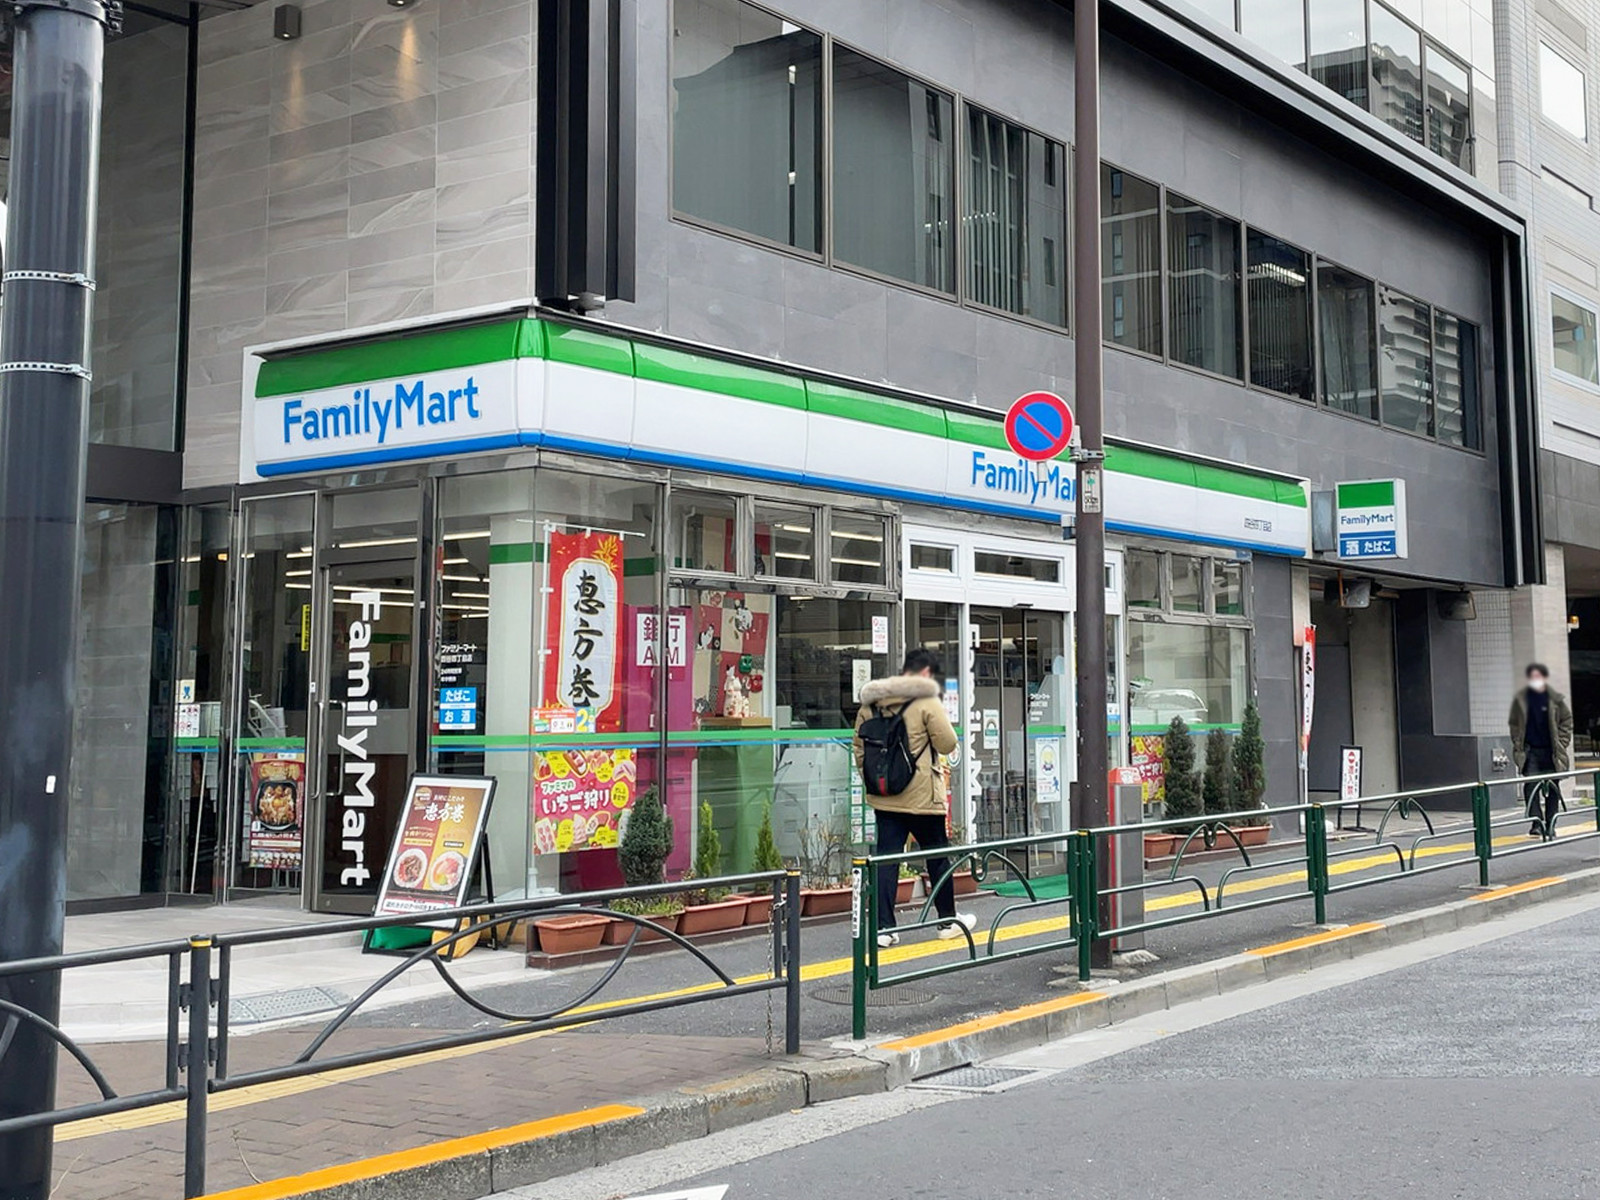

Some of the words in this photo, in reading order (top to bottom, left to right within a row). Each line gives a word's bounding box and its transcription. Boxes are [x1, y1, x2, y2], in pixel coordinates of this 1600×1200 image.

[284, 377, 480, 443] FamilyMart
[972, 451, 1077, 504] FamilyMa
[1341, 513, 1394, 526] FamilyMart
[1346, 541, 1359, 555] 酒
[1364, 540, 1391, 553] たばこ
[568, 569, 605, 708] 恵方巻
[643, 646, 680, 664] AM
[445, 689, 471, 702] たばこ
[337, 591, 381, 887] FamilyMart
[541, 781, 575, 794] ファミマの
[542, 788, 610, 814] いちご狩り
[422, 802, 466, 823] 恵方巻
